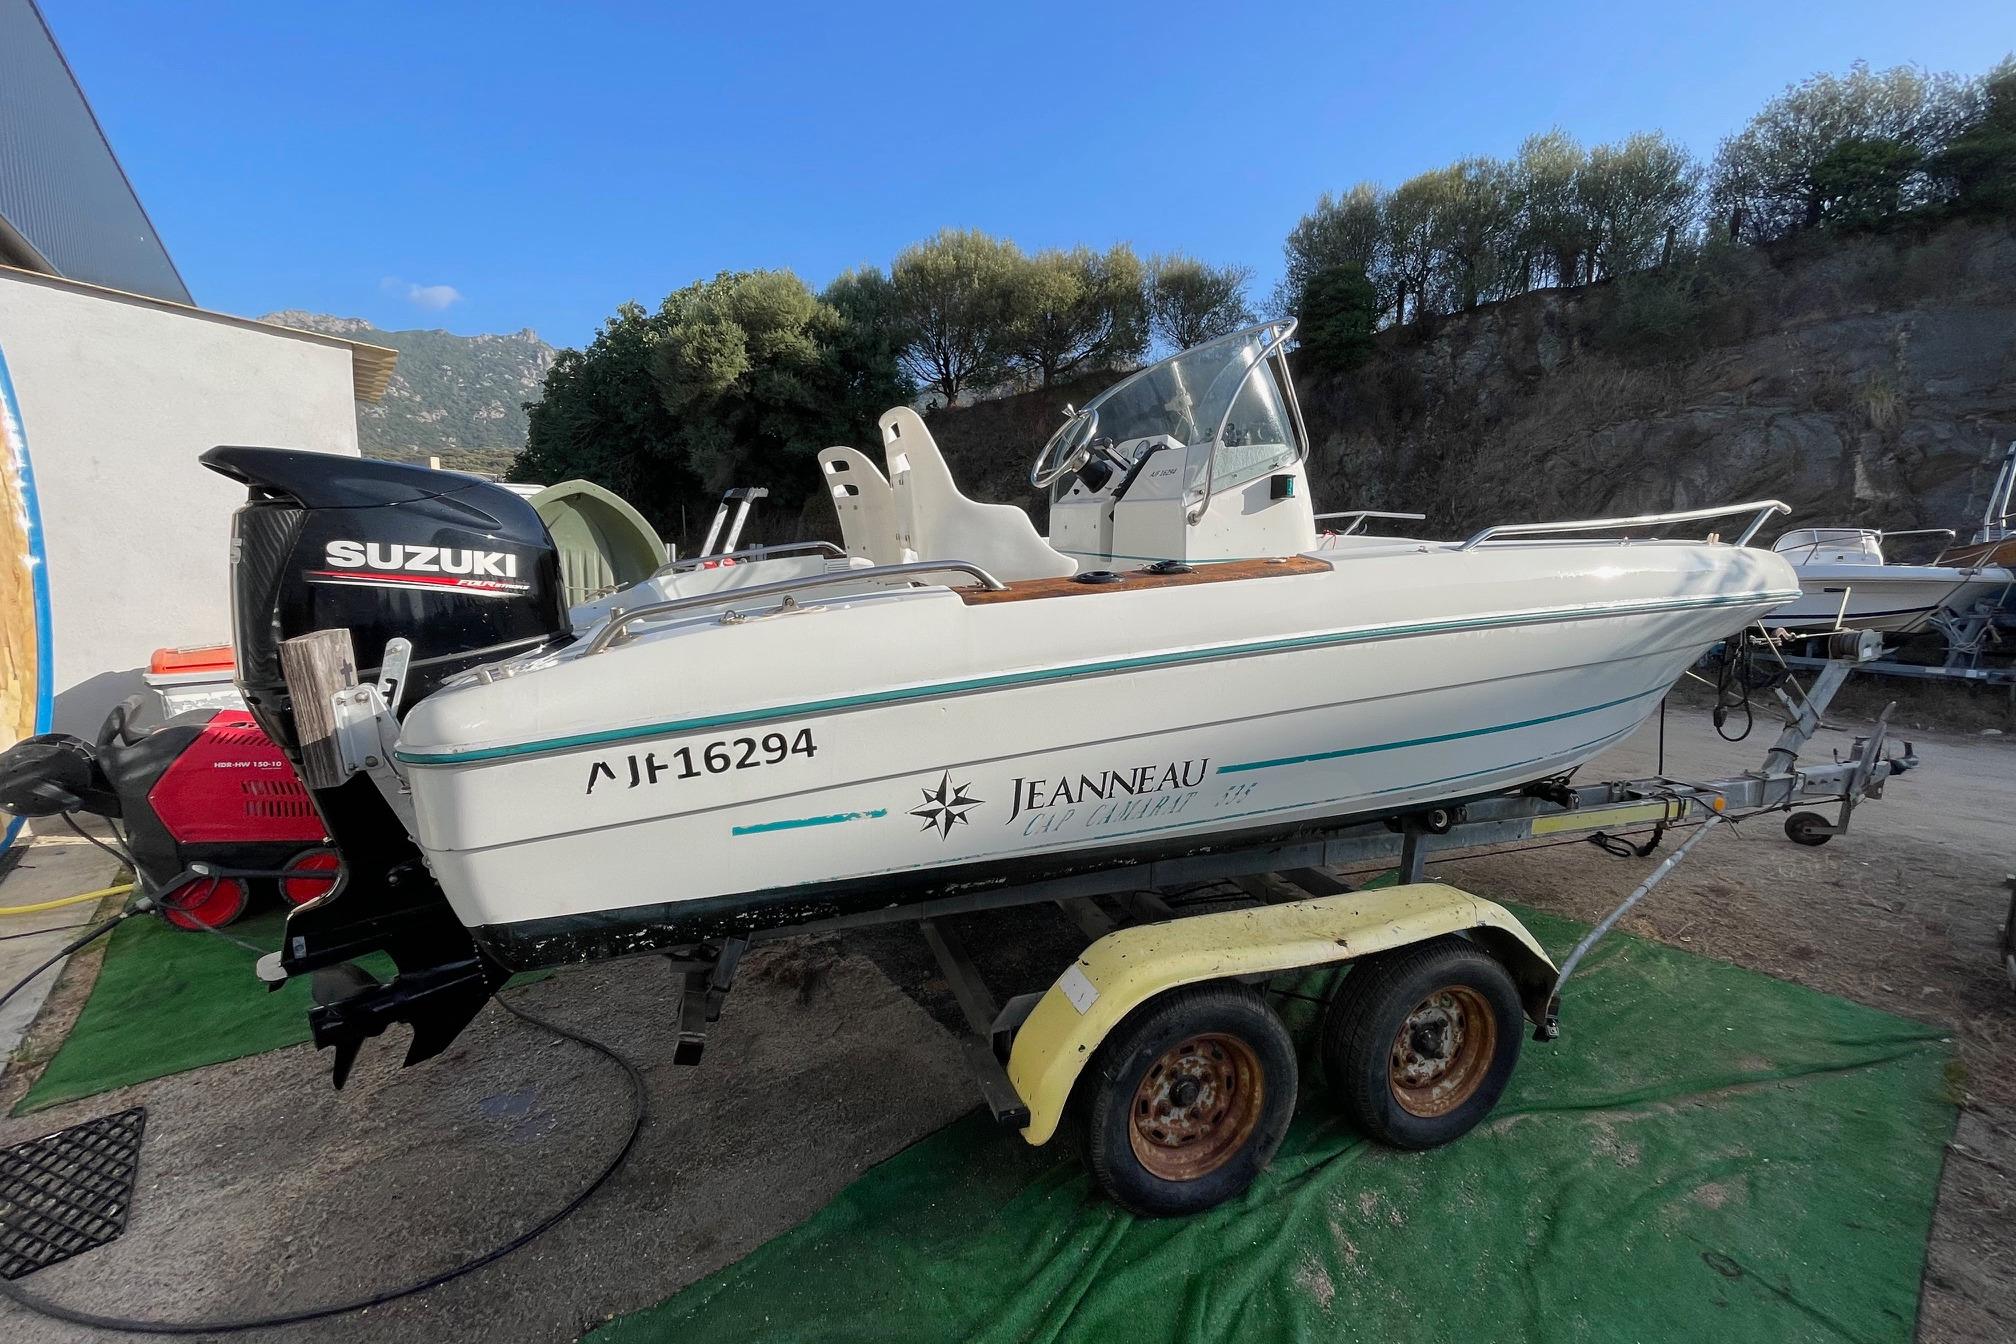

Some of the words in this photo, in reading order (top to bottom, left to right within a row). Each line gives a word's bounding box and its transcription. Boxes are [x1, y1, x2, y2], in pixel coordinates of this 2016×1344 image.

[326, 540, 517, 578] SUZUKI
[253, 761, 282, 769] 150-10
[1005, 758, 1211, 825] JEANNEAU
